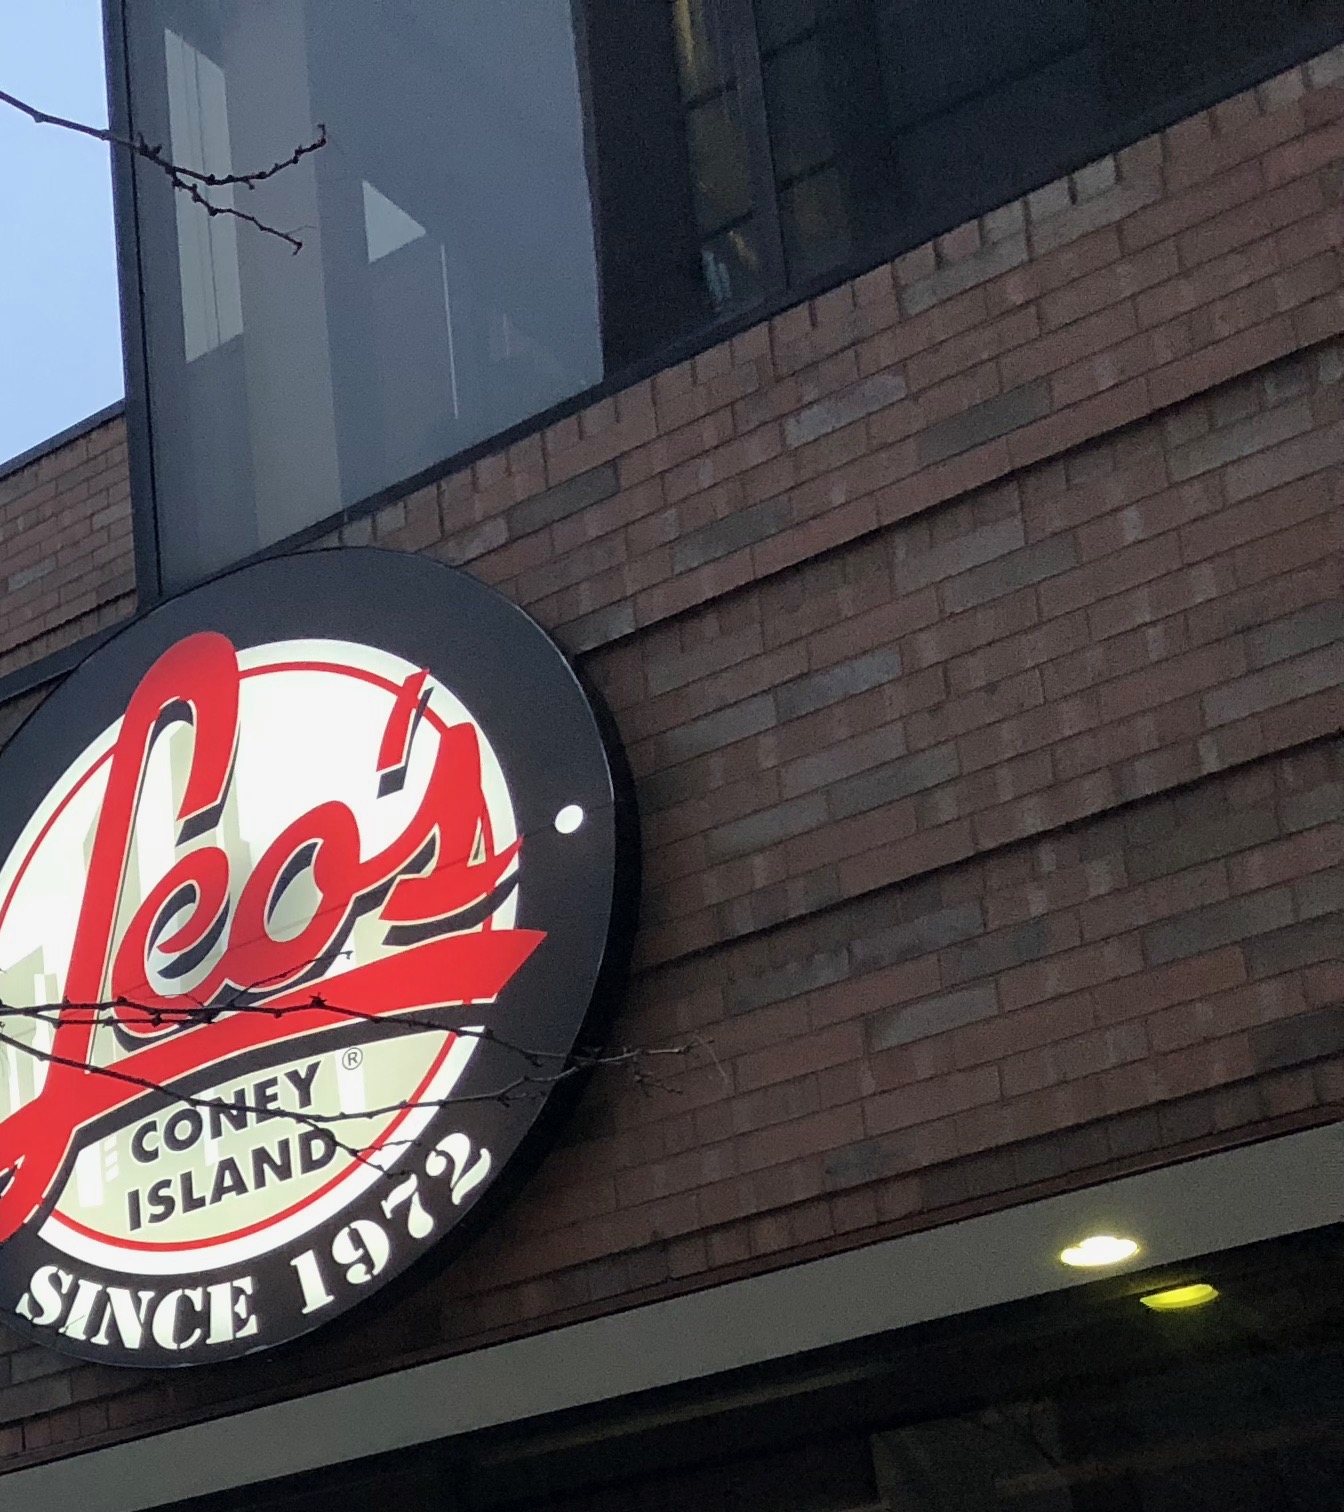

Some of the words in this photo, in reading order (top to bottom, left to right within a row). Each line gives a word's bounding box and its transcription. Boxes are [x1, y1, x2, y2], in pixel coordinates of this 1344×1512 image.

[131, 1060, 322, 1164] CONEY
[127, 1128, 338, 1232] ISLAND
[16, 1265, 260, 1350] SINCE
[289, 1132, 493, 1315] 1972
